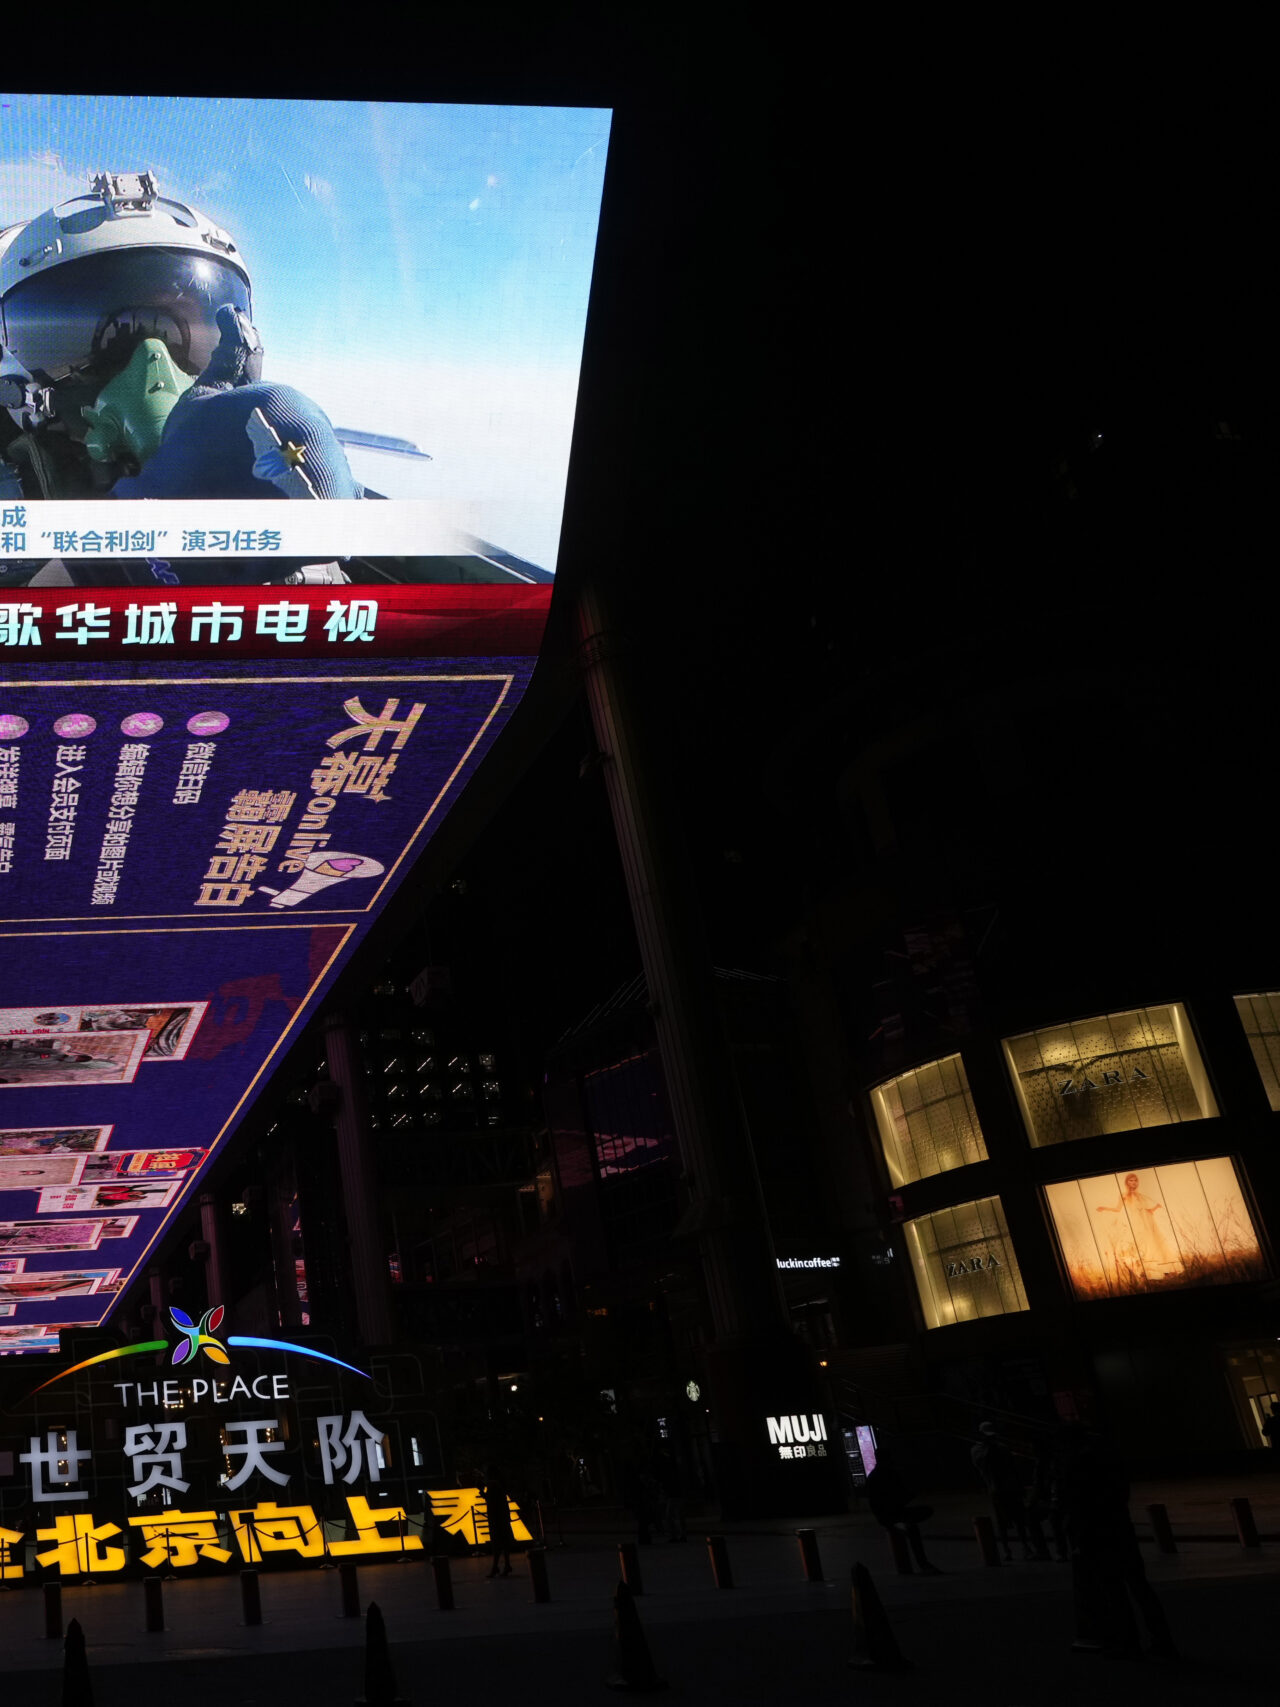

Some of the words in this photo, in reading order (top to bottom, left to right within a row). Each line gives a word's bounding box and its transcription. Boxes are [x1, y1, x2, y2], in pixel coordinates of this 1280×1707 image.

[310, 696, 427, 797] 天幕
[173, 741, 218, 804] 微信扫码
[44, 745, 87, 861] 进入会员支付页面
[298, 797, 337, 830] on
[90, 743, 152, 905] 编辑你想分享的图片或视频
[194, 788, 298, 906] 霸屏告白
[278, 833, 332, 874] live
[1059, 1066, 1151, 1096] ZARA
[945, 1253, 1001, 1279] ZARA
[114, 1381, 180, 1408] THE
[192, 1375, 290, 1404] PLACE
[766, 1414, 828, 1445] MUJI
[20, 1410, 386, 1502] 世贸天阶
[778, 1444, 828, 1460] 無印良品
